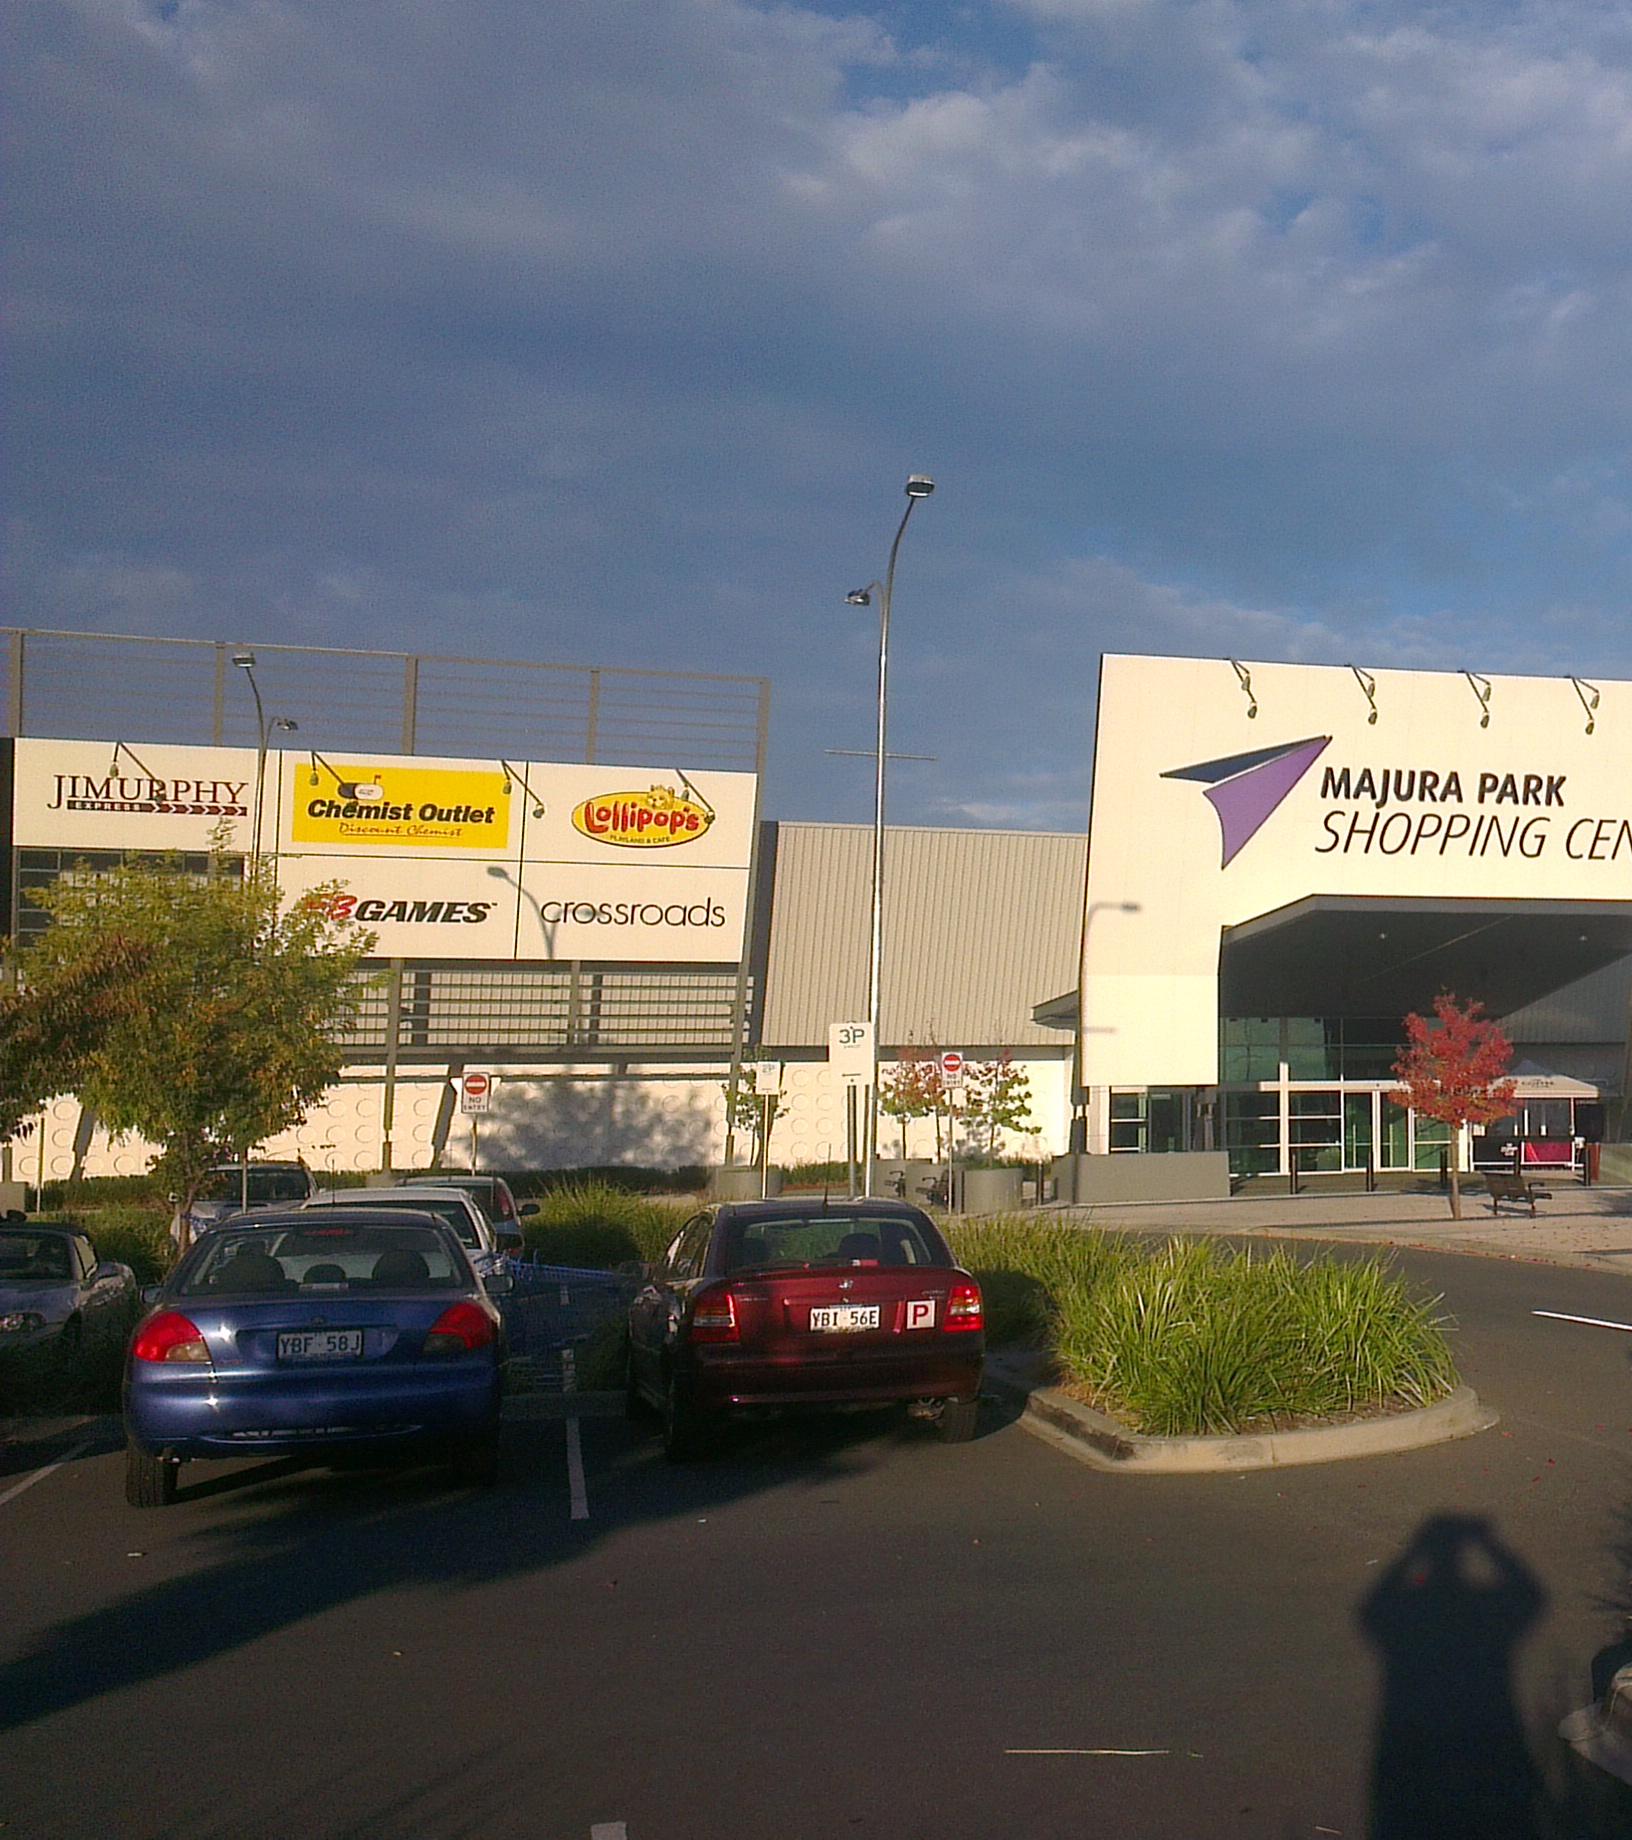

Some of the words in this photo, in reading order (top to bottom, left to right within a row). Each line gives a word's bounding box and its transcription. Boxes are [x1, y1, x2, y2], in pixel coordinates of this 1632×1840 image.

[1320, 767, 1464, 809] MAJURA
[1477, 773, 1566, 807] PARK
[75, 802, 141, 812] EXPRESS
[308, 799, 413, 821] Chemist
[419, 803, 496, 824] Outlet
[339, 822, 401, 834] Discount
[406, 824, 463, 837] Chemist
[1314, 810, 1551, 858] SHOPPING
[354, 900, 492, 924] GAMES
[540, 897, 726, 927] crossroads
[839, 1028, 865, 1044] 3P
[812, 1312, 838, 1327] YBI
[850, 1311, 877, 1326] 56E
[912, 1304, 929, 1325] P
[327, 1334, 360, 1351] 58J
